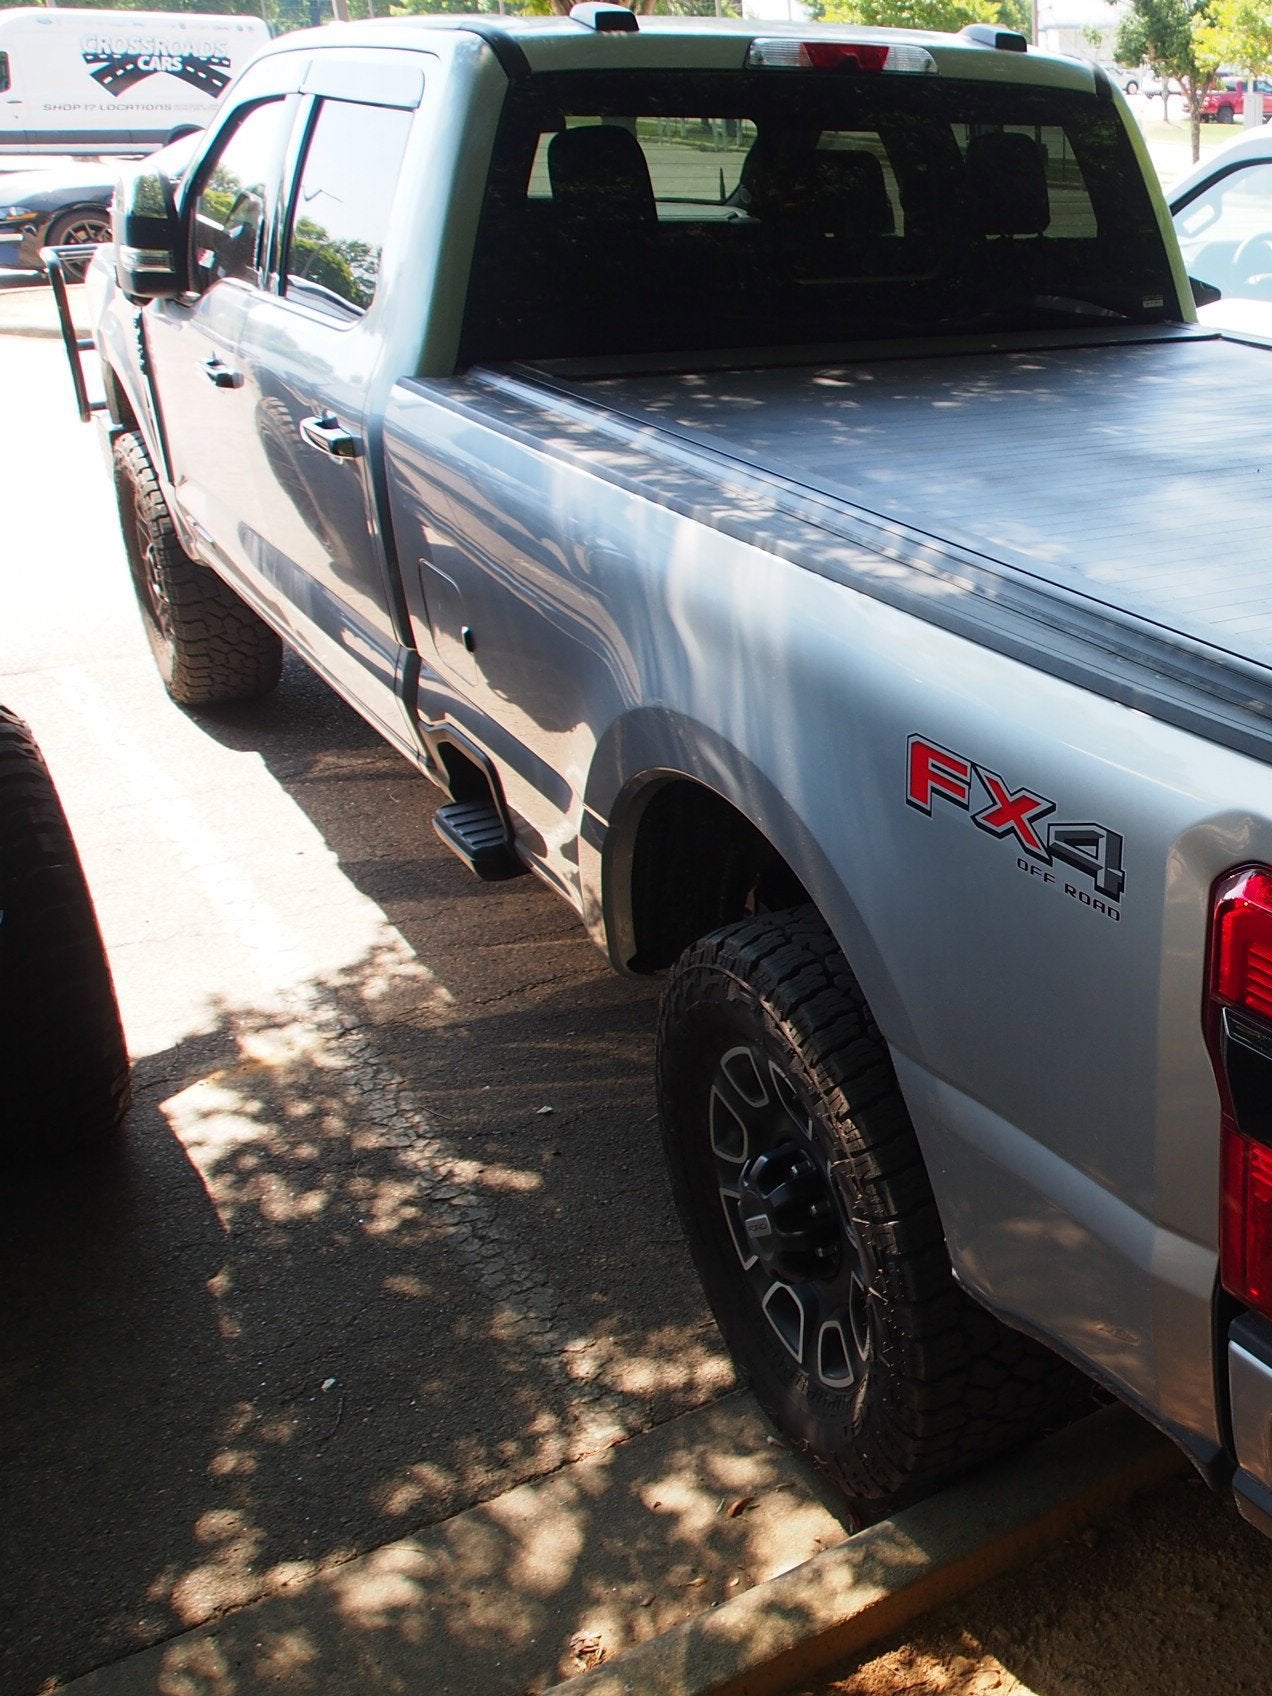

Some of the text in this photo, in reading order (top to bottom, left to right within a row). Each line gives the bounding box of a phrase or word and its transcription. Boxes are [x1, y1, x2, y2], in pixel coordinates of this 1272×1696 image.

[80, 34, 230, 58] CROSSROADS
[137, 55, 183, 72] CARS
[906, 733, 1125, 903] FX4
[1017, 857, 1120, 922] OFF ROAD
